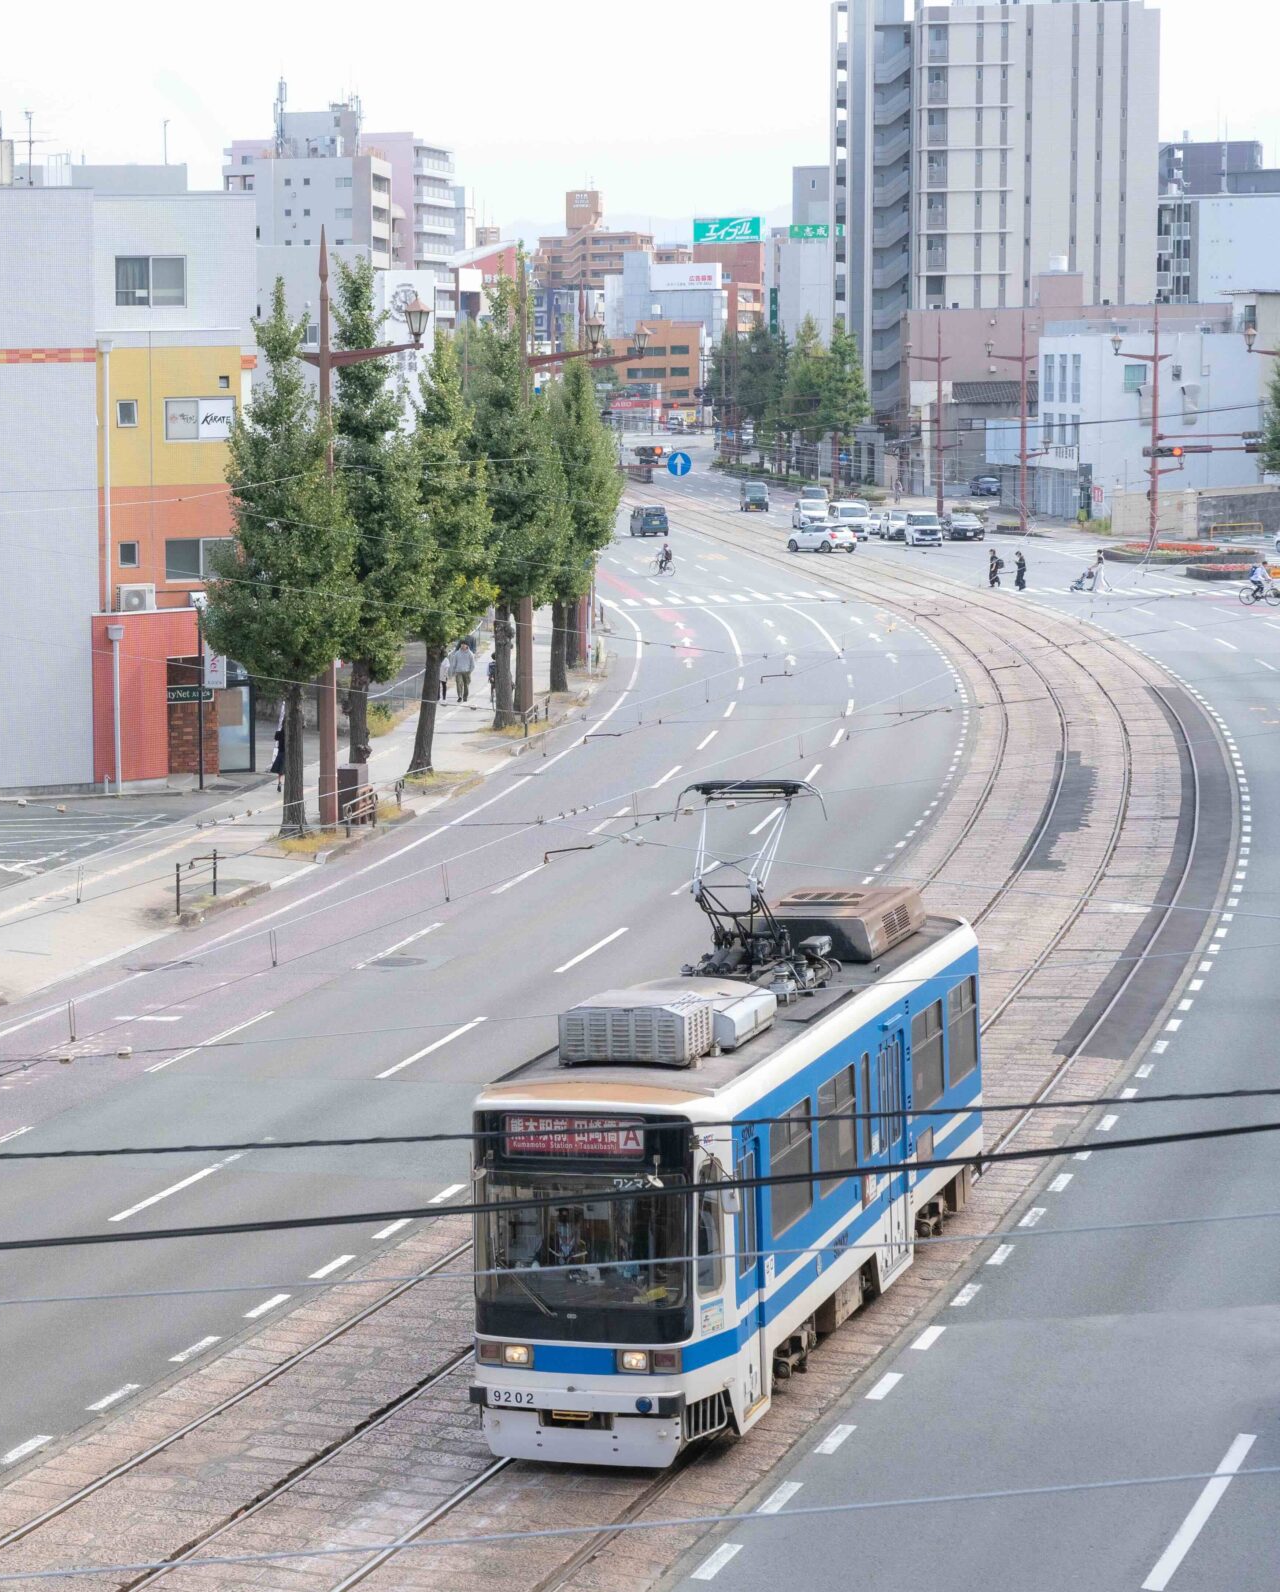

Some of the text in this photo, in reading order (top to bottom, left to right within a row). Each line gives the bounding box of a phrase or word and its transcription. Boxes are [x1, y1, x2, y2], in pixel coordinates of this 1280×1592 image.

[700, 218, 755, 241] エイブル
[201, 412, 231, 425] KARATE
[513, 1141, 546, 1149] Kumamoto
[493, 1390, 534, 1404] 9202
